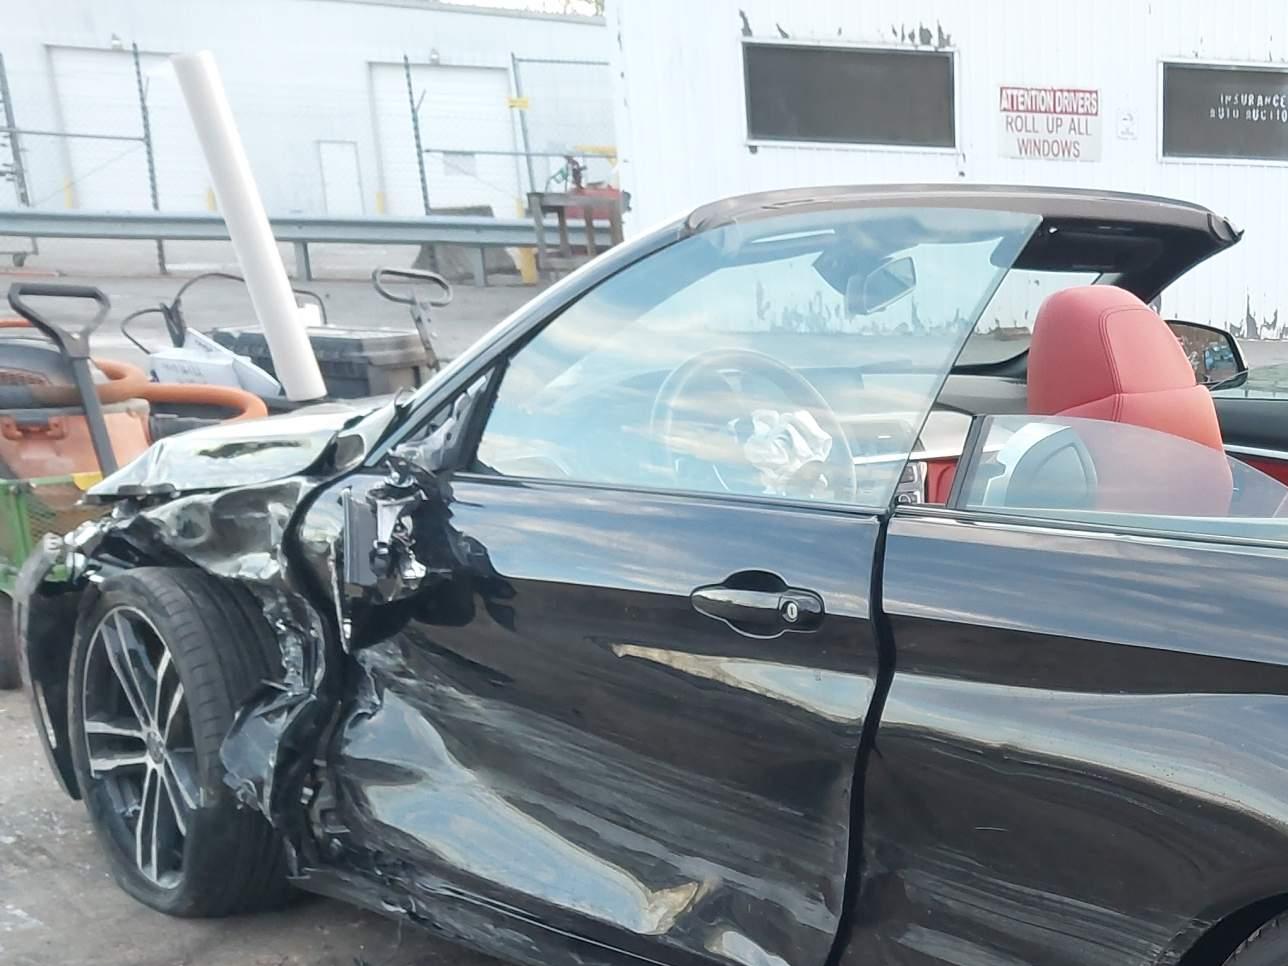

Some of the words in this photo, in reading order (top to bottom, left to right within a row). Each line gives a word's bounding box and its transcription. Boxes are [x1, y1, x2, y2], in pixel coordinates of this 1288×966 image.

[1000, 88, 1055, 114] ATTENTION
[1054, 90, 1097, 114] DRIVERS
[1220, 93, 1287, 108] INSURANCE
[1005, 115, 1040, 133] ROLL
[1045, 117, 1063, 134] UP
[1068, 117, 1093, 136] ALL
[1016, 138, 1081, 159] WINDOWS
